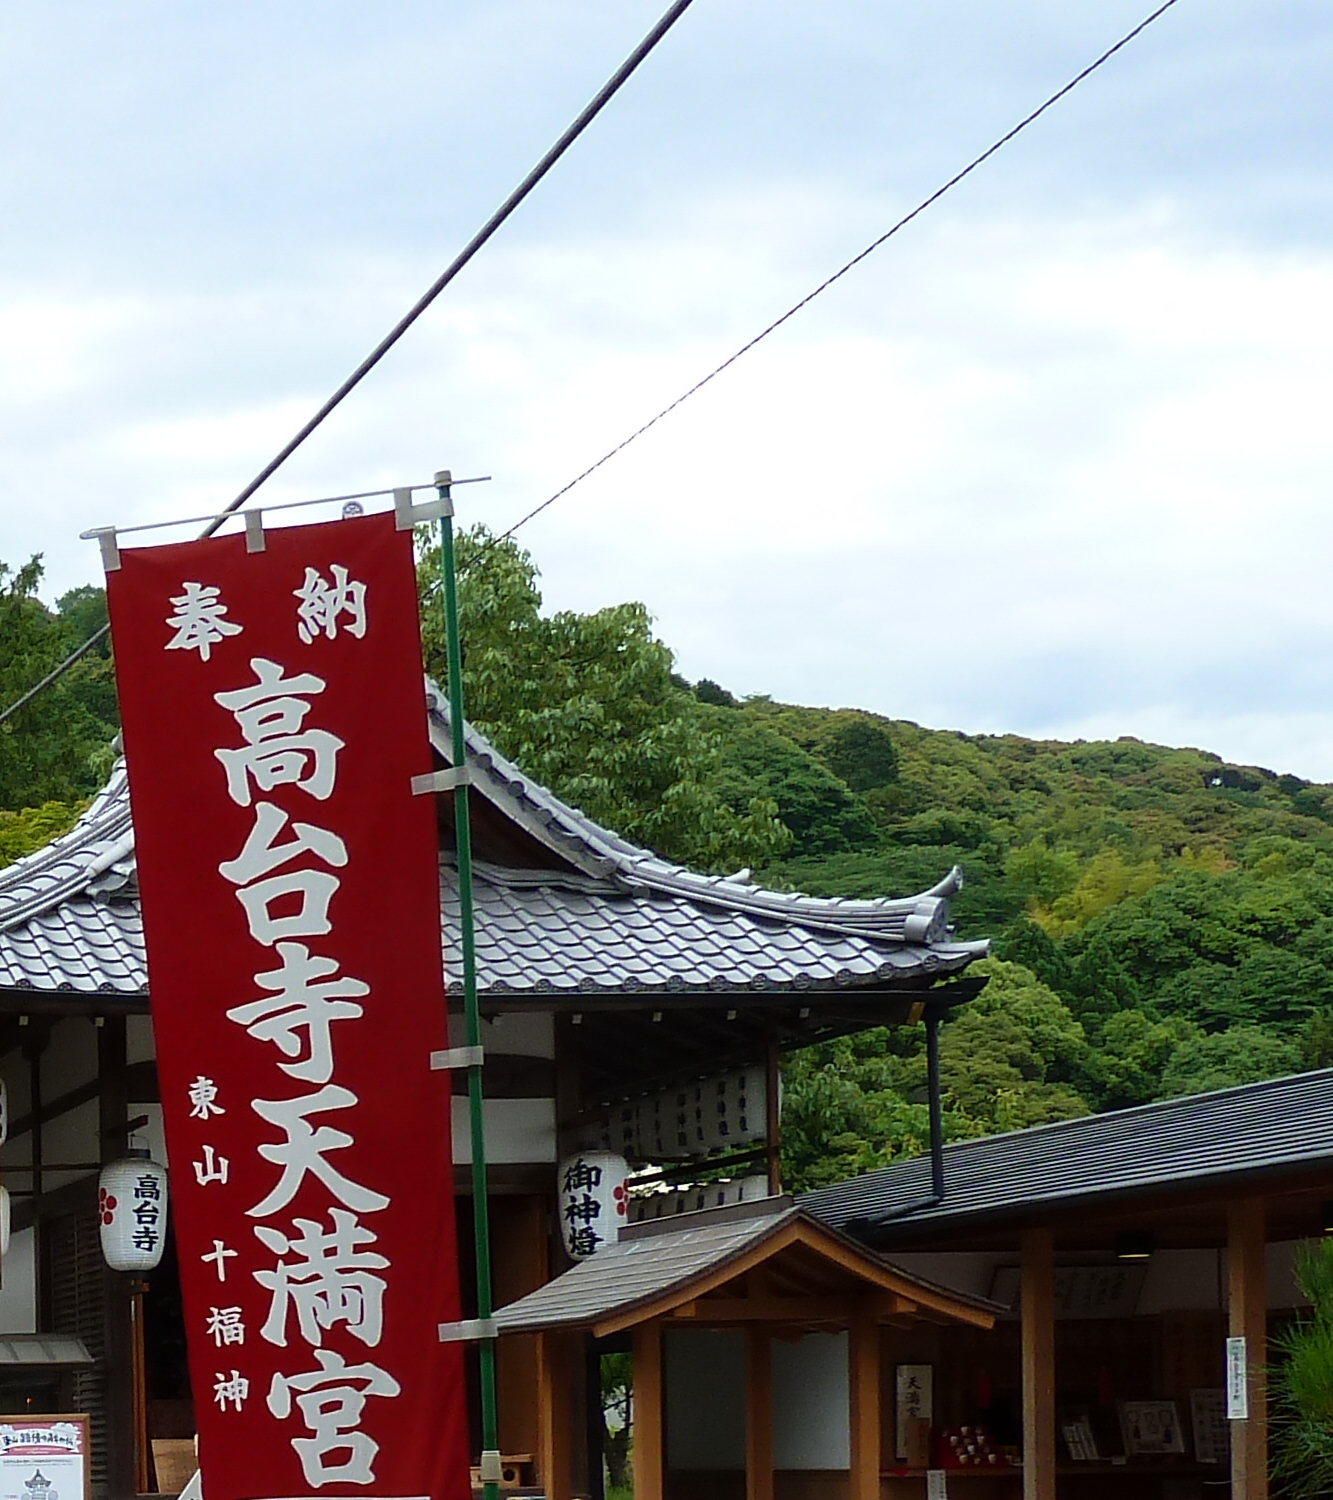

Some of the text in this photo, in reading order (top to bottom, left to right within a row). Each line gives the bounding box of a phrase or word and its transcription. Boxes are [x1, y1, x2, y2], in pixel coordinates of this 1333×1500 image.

[164, 563, 367, 662] 奉納
[213, 658, 401, 1488] 高台寺天満宮
[132, 1174, 162, 1252] 高台寺
[188, 1075, 250, 1413] 東山十福神
[563, 1157, 603, 1256] 御神燈
